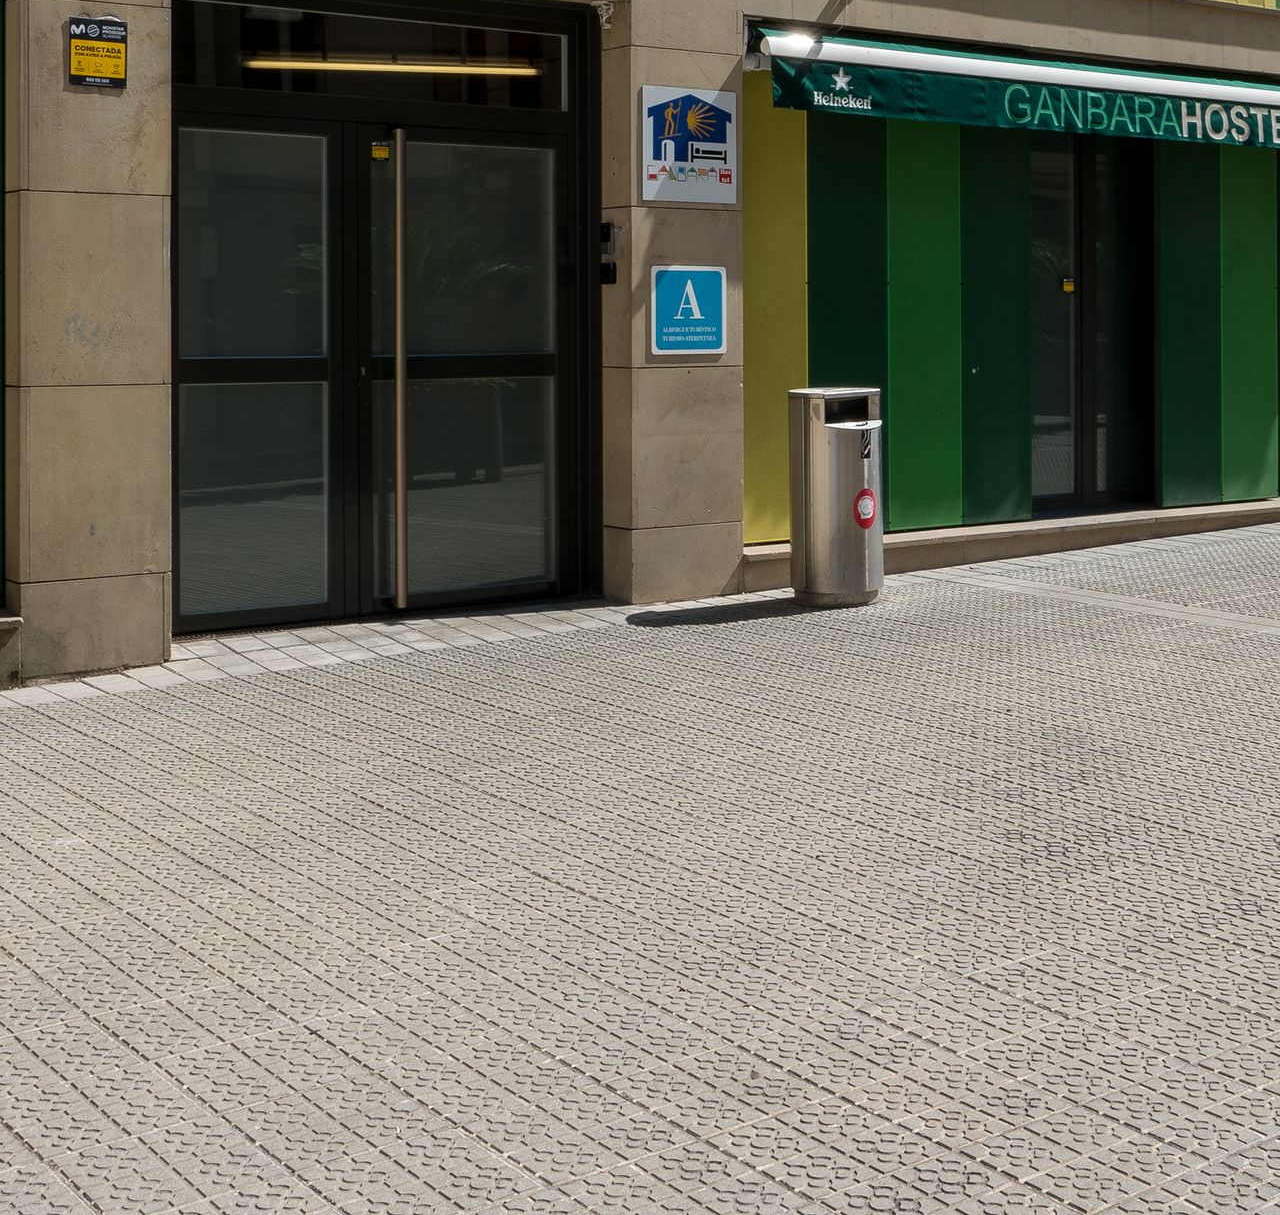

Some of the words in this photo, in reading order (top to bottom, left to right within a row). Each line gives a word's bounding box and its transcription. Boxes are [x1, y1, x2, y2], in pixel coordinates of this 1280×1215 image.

[74, 45, 122, 54] CONECTADA
[813, 90, 872, 110] Heineken
[673, 278, 706, 320] A
